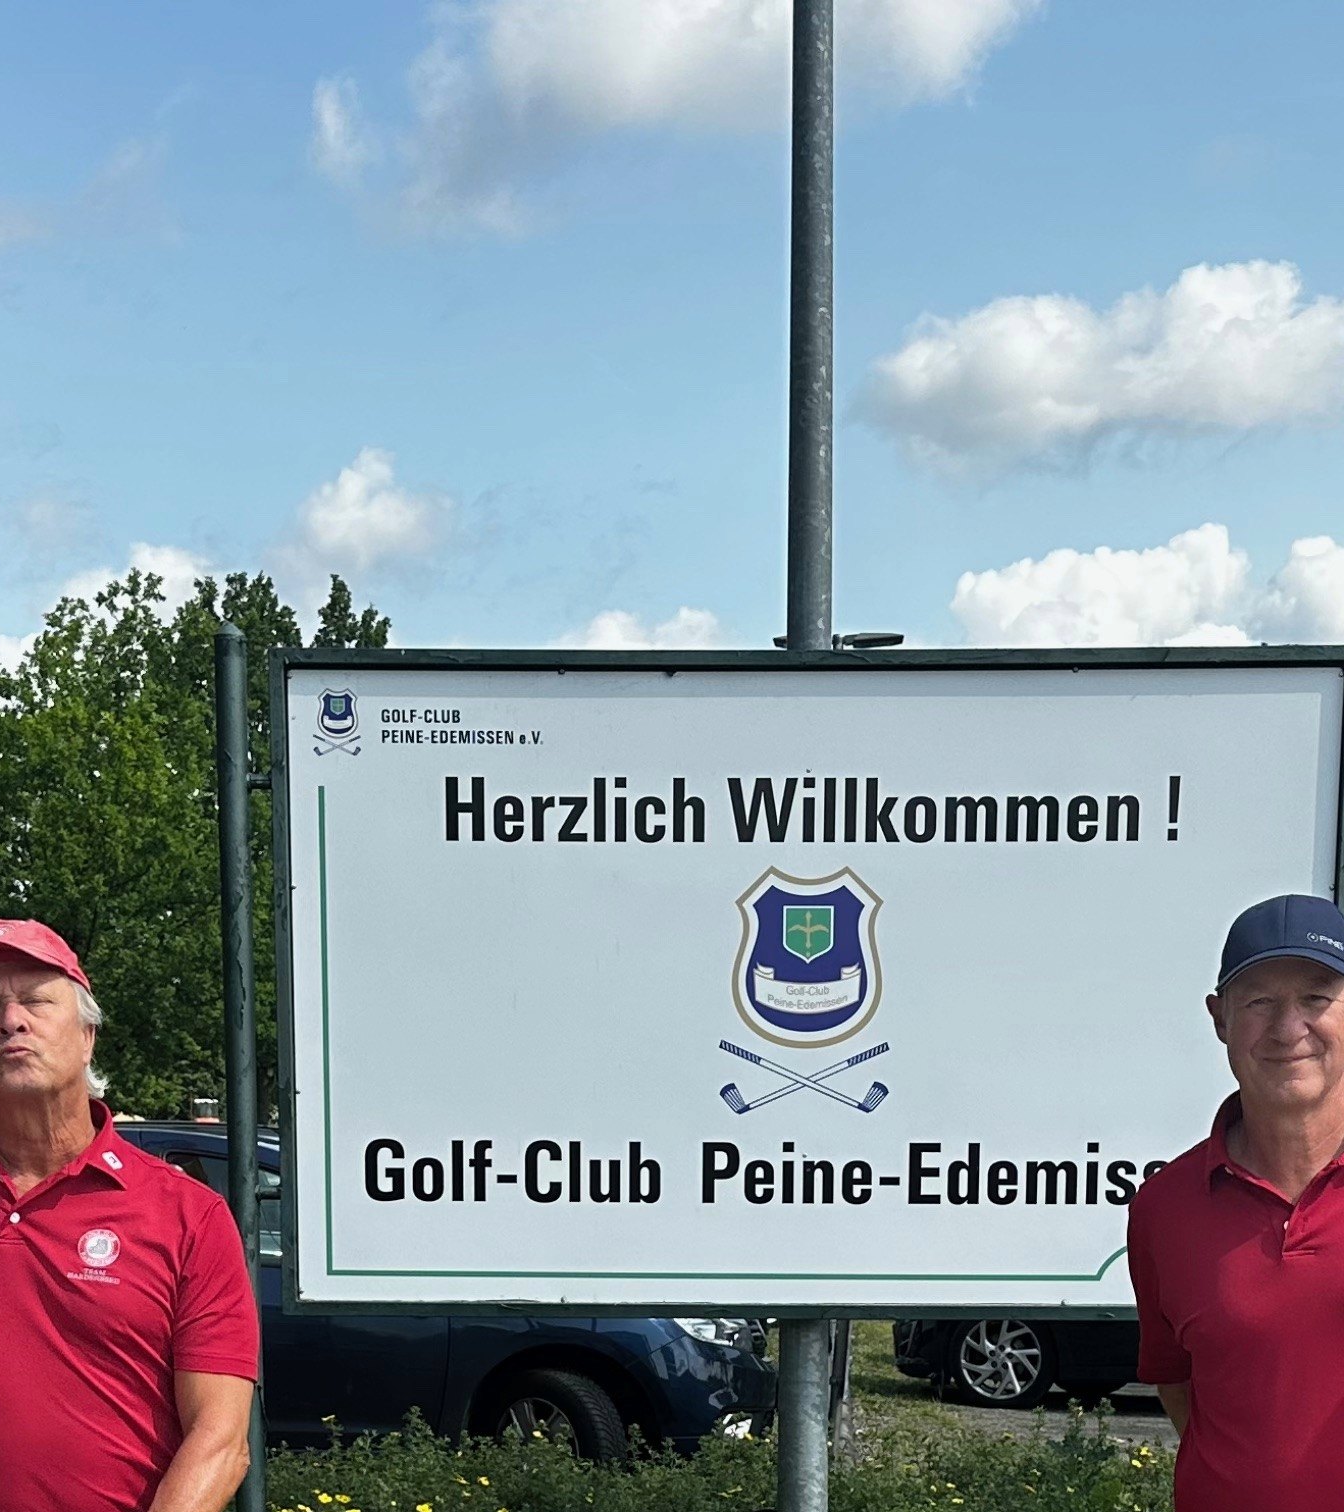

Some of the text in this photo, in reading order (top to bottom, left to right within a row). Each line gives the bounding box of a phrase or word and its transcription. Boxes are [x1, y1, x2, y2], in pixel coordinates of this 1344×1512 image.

[380, 708, 461, 724] GOLF-CLUB
[380, 729, 544, 746] PEINE-EDEMISSEN e.V.
[444, 775, 1182, 843] Herzlich Willkommen !
[785, 985, 830, 996] Golf-Club
[767, 994, 848, 1010] Peine-Edemissen
[364, 1138, 662, 1204] Golf-Club
